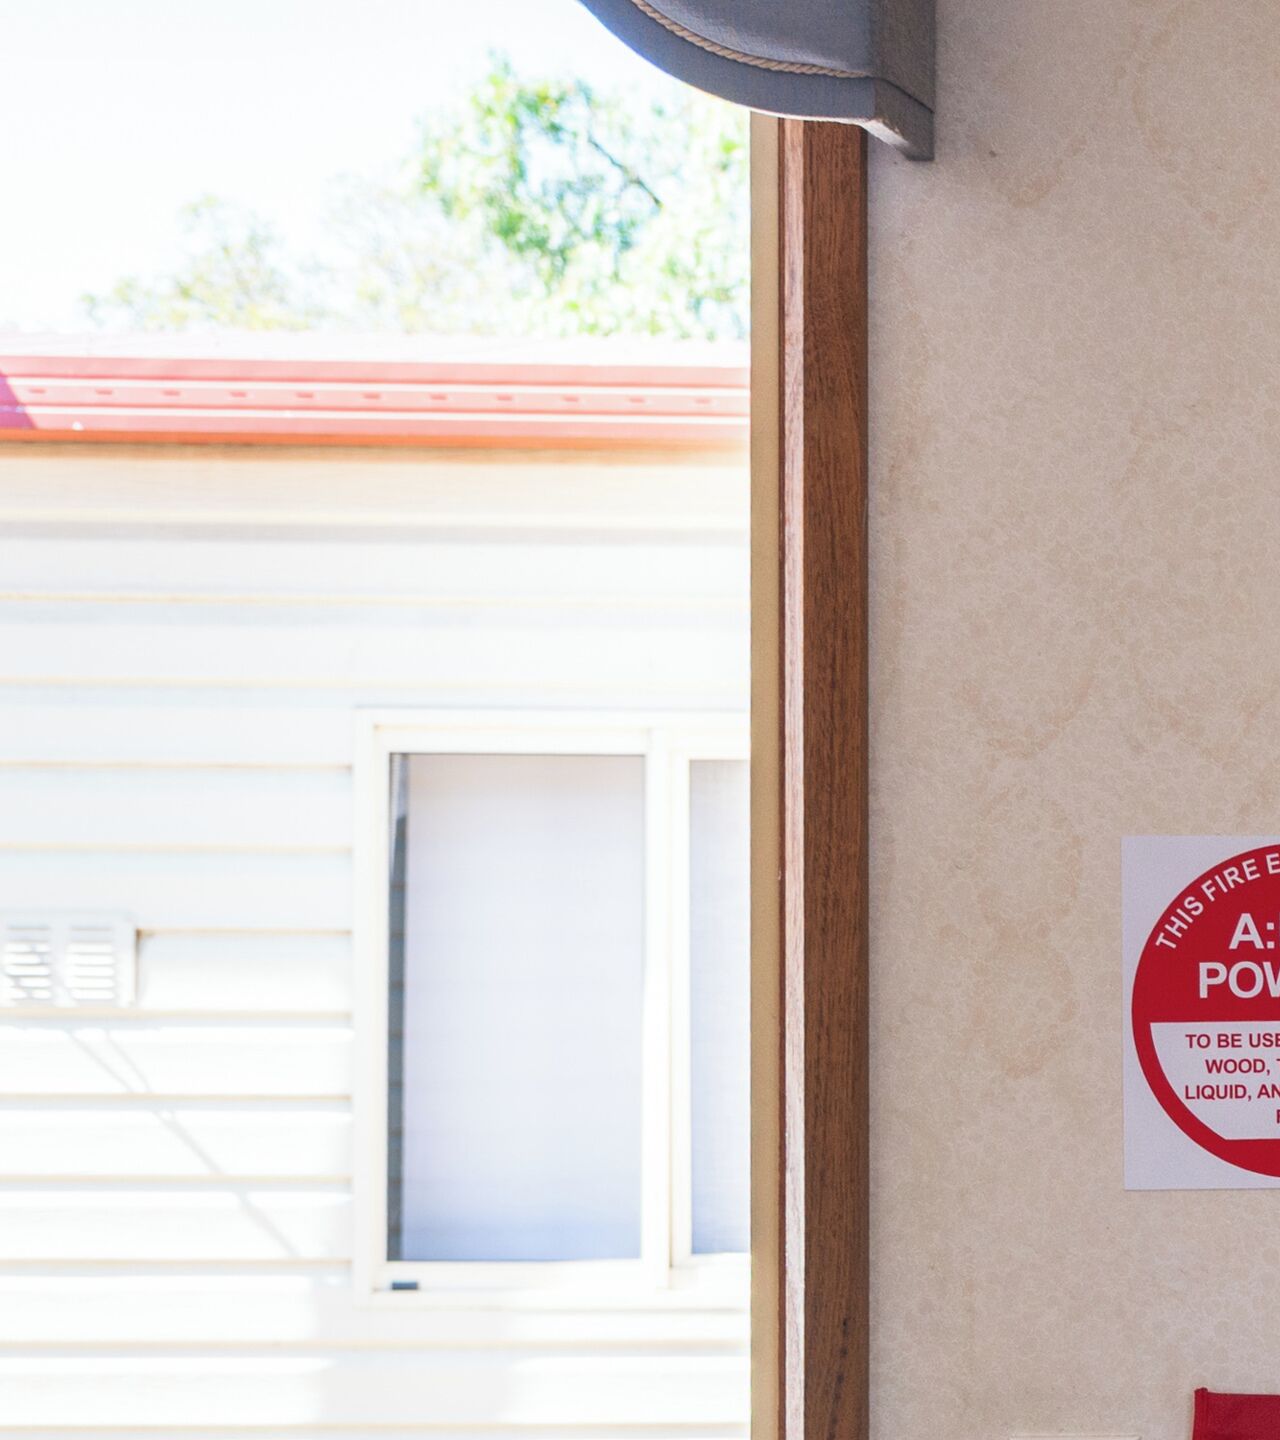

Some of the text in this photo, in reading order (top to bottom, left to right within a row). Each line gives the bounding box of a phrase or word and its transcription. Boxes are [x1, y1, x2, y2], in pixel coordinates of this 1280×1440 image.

[1156, 896, 1203, 951] THIS
[1201, 858, 1260, 901] FIRE
[1185, 1034, 1210, 1048] TO
[1218, 1034, 1242, 1047] BE
[1205, 1059, 1270, 1075] WOOD,
[1185, 1084, 1252, 1101] LIQUID,
